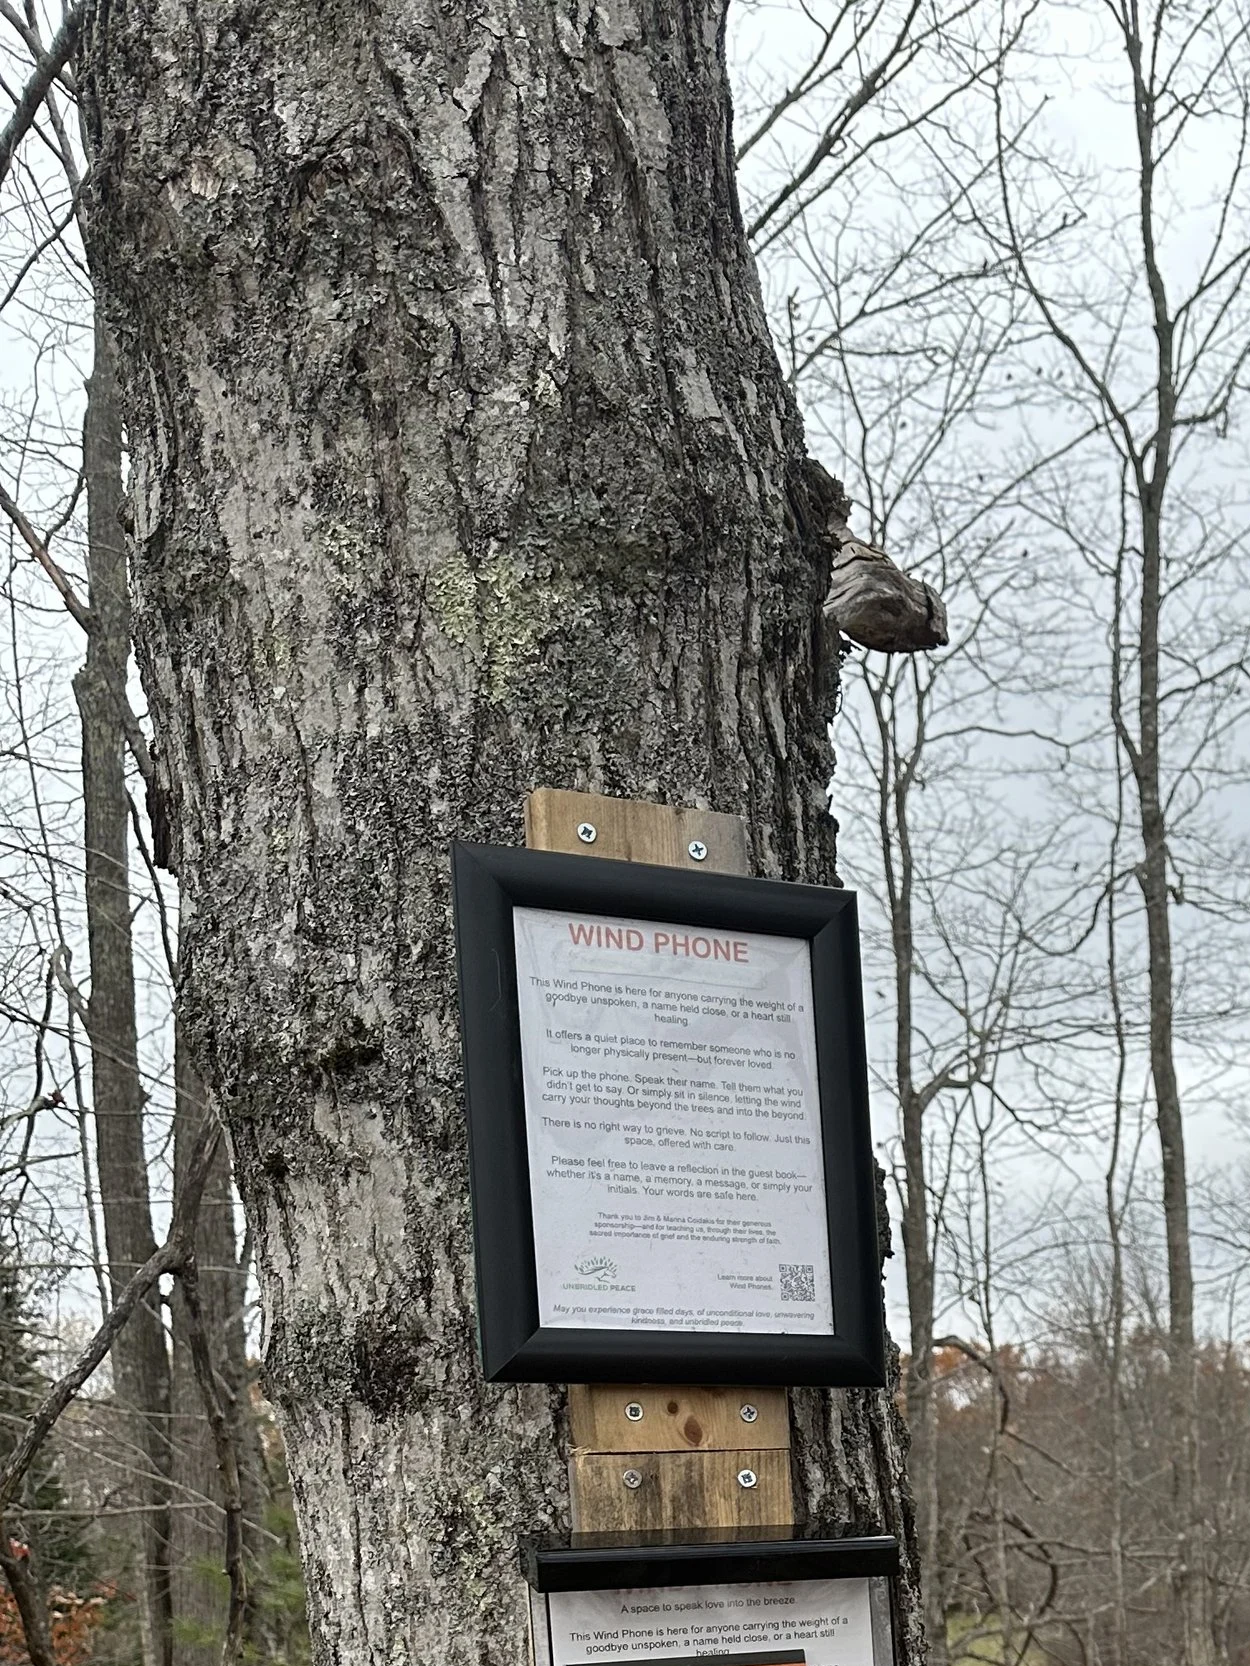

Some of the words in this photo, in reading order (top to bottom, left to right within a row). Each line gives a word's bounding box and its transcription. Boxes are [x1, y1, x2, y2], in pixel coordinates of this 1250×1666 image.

[568, 922, 643, 951] WIND
[654, 932, 748, 963] PHONE
[528, 975, 550, 987] This
[552, 978, 578, 990] Wind
[580, 980, 612, 993] Phone
[624, 984, 646, 996] here
[663, 991, 698, 1002] anyone
[700, 994, 737, 1007] carrying
[738, 996, 754, 1007] the
[755, 1000, 785, 1011] weight
[544, 991, 587, 1005] goodbye
[590, 996, 639, 1009] unspoken,
[650, 1001, 677, 1011] name
[679, 1002, 699, 1013] held
[750, 1009, 775, 1021] heart
[775, 1013, 791, 1023] still
[554, 1029, 582, 1040] offers
[593, 1034, 618, 1044] quiet
[619, 1035, 646, 1046] place
[659, 1039, 707, 1051] remember
[708, 1044, 751, 1056] someone
[752, 1047, 772, 1057] who
[570, 1042, 601, 1056] longer
[603, 1046, 650, 1060] physically
[713, 1055, 745, 1067] forever
[542, 1065, 563, 1077] Pick
[580, 1069, 596, 1079] the
[634, 1073, 665, 1085] Speak
[666, 1076, 688, 1086] their
[720, 1080, 736, 1090] Tell
[737, 1082, 761, 1093] them
[762, 1085, 785, 1094] what
[786, 1088, 803, 1096] you
[541, 1093, 566, 1104] carry
[569, 1095, 590, 1105] your
[592, 1095, 635, 1110] thoughts
[636, 1098, 672, 1111] beyond
[673, 1101, 689, 1111] the
[690, 1103, 714, 1113] trees
[716, 1106, 733, 1115] and
[735, 1106, 752, 1116] into
[754, 1108, 769, 1118] the
[574, 1082, 591, 1093] get
[641, 1086, 672, 1100] simply
[734, 1094, 762, 1106] letting
[763, 1096, 778, 1106] the
[779, 1096, 801, 1108] wind
[541, 1116, 570, 1128] There
[583, 1121, 596, 1129] no
[598, 1120, 620, 1132] right
[622, 1124, 642, 1135] way
[643, 1124, 653, 1133] to
[689, 1127, 703, 1137] No
[705, 1129, 730, 1140] script
[774, 1133, 792, 1143] Just
[794, 1135, 810, 1144] this
[623, 1136, 655, 1146] space,
[657, 1136, 690, 1148] offered
[692, 1140, 711, 1149] with
[551, 1155, 585, 1166] Please
[586, 1157, 605, 1167] feel
[607, 1158, 626, 1169] free
[628, 1160, 638, 1169] to
[640, 1160, 666, 1171] leave
[676, 1163, 719, 1174] reflection
[731, 1167, 746, 1176] the
[747, 1169, 773, 1178] guest
[546, 1167, 585, 1179] whether
[612, 1173, 642, 1183] name,
[750, 1181, 760, 1189] or
[762, 1181, 791, 1192] simply
[792, 1184, 812, 1193] your
[641, 1185, 664, 1195] Your
[665, 1188, 694, 1197] words
[696, 1190, 712, 1198] are
[712, 1190, 734, 1199] safe
[609, 1284, 636, 1292] PEACE
[630, 1604, 660, 1614] space
[662, 1603, 672, 1611] to
[673, 1600, 703, 1612] speak
[704, 1600, 724, 1609] love
[727, 1599, 744, 1607] into
[746, 1598, 761, 1606] the
[569, 1632, 591, 1641] This
[592, 1629, 619, 1640] Wind
[620, 1628, 653, 1638] Phone
[666, 1626, 688, 1635] here
[690, 1624, 704, 1634] for
[705, 1624, 740, 1634] anyone
[741, 1621, 779, 1632] carrying
[781, 1619, 796, 1628] the
[798, 1617, 829, 1628] weight
[830, 1616, 840, 1625] of
[585, 1642, 629, 1654] goodbye
[630, 1639, 680, 1650] unspoken,
[692, 1637, 719, 1645] name
[720, 1633, 741, 1643] held
[793, 1629, 818, 1639] heart
[819, 1628, 834, 1637] still
